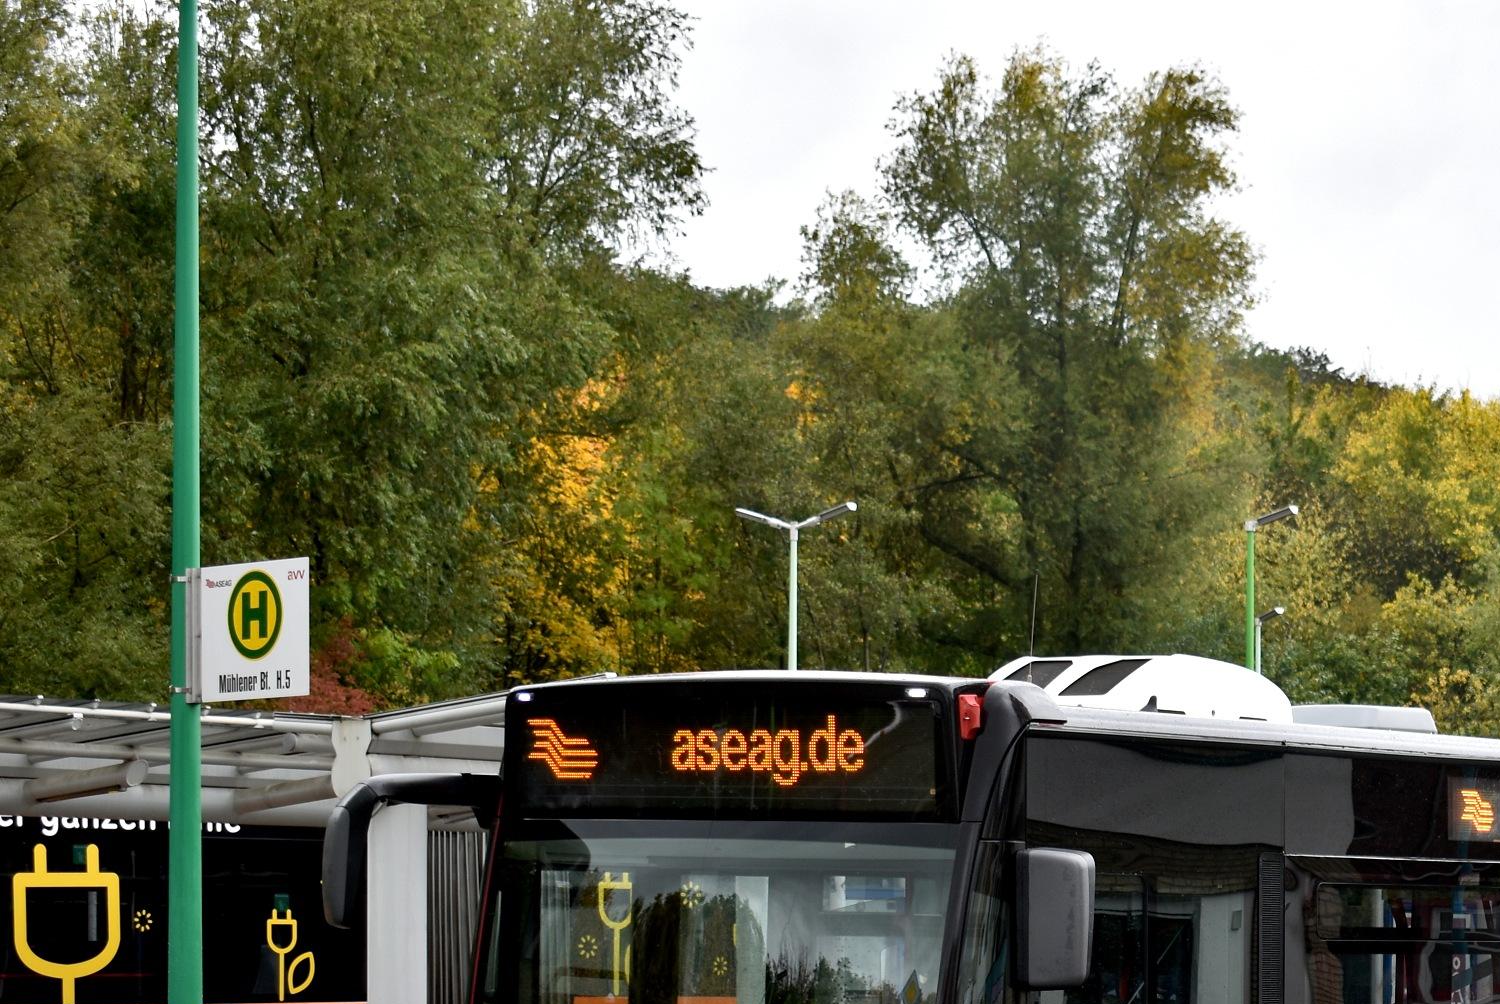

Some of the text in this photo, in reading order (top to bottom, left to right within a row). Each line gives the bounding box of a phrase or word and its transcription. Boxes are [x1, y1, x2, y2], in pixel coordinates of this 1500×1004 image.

[241, 590, 268, 640] H
[219, 674, 257, 693] Mühlener
[276, 670, 291, 689] H.5
[672, 715, 864, 785] aseag.de
